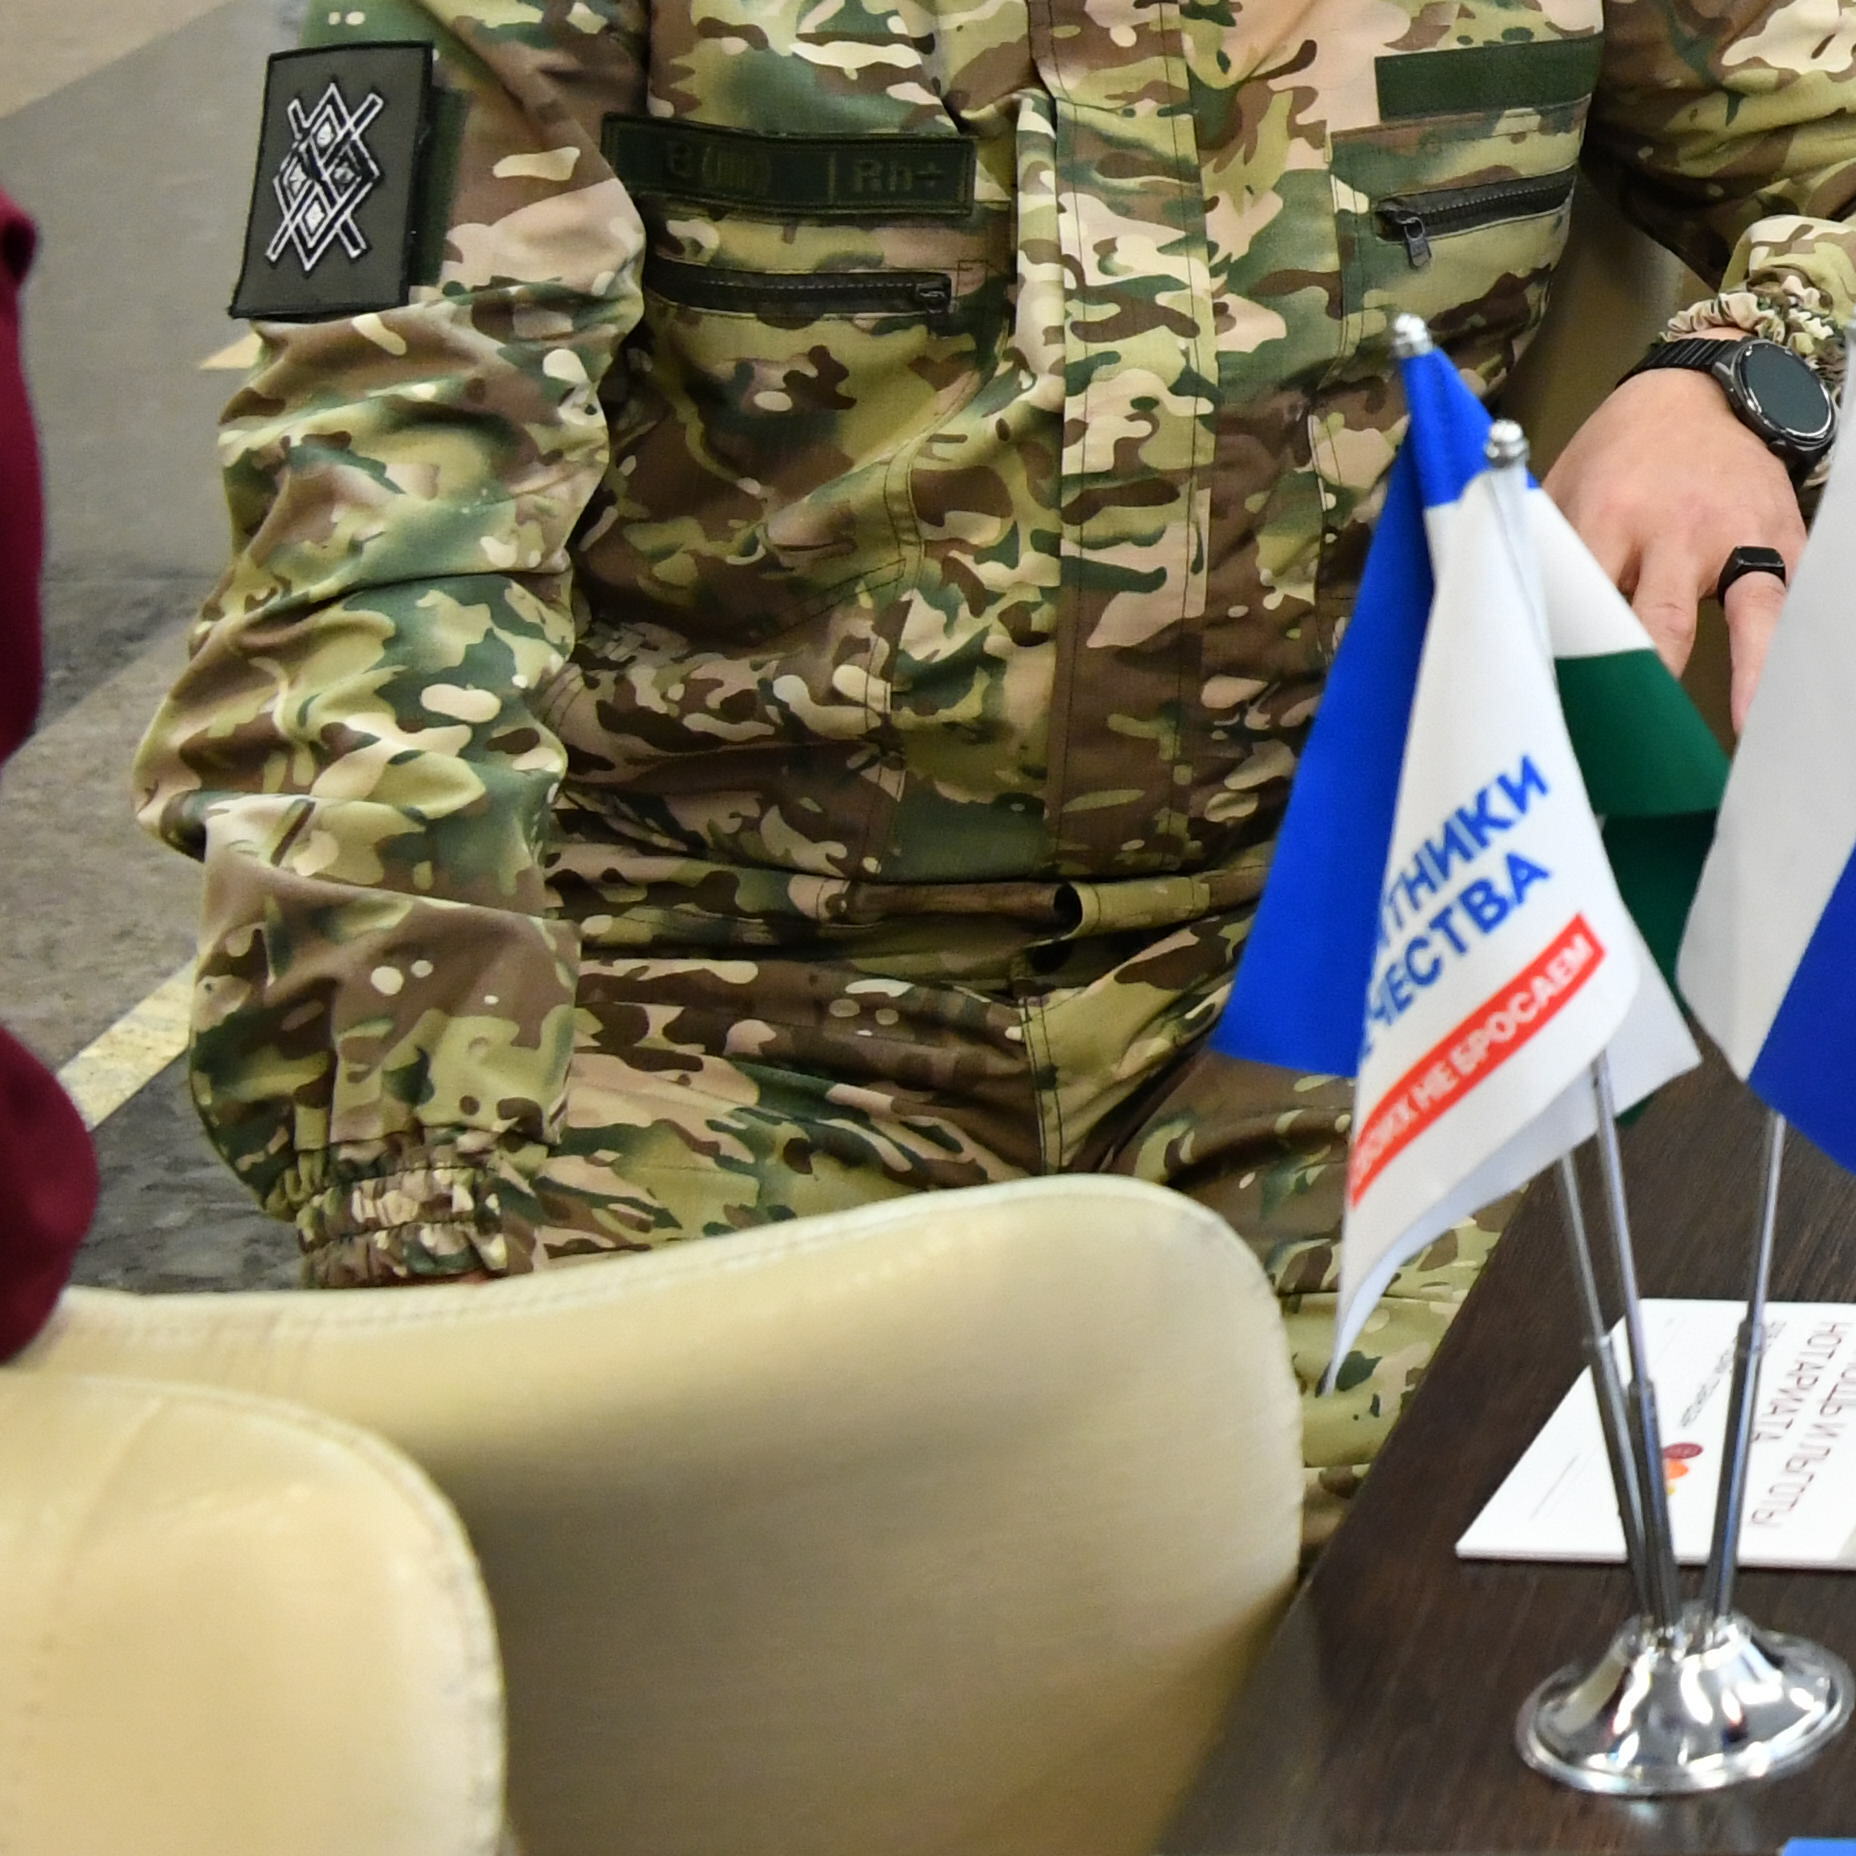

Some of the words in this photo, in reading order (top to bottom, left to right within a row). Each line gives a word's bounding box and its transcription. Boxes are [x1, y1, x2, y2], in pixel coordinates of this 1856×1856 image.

[1382, 752, 1552, 940] ТНИКИ
[1370, 850, 1554, 1028] ЧЕСТВА
[1411, 1062, 1460, 1110] НЕ
[1448, 931, 1595, 1078] БРОСАЕМ
